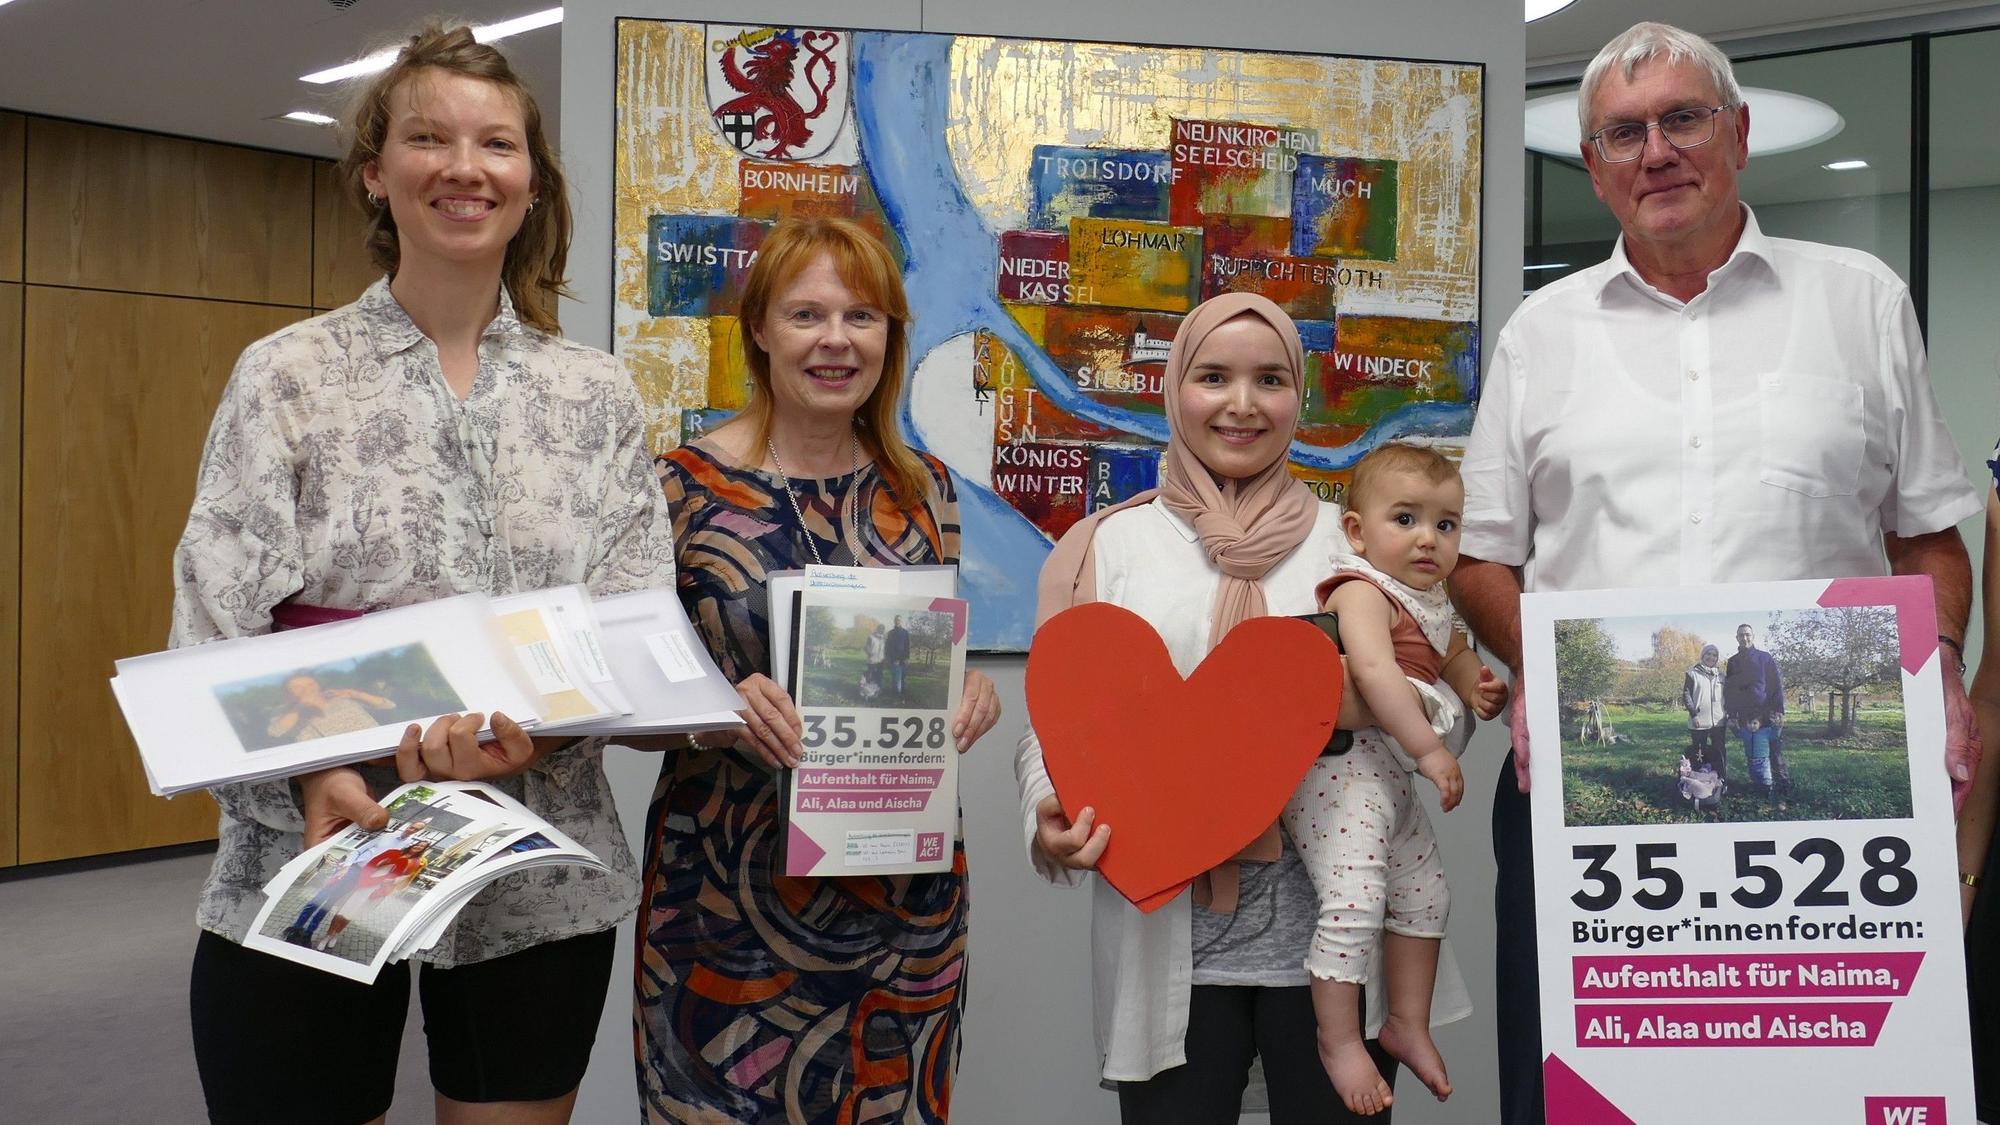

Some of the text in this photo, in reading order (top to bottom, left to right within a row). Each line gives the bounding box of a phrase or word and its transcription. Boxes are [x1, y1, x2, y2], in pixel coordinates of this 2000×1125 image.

[1177, 122, 1315, 150] NEUNKIRCHEN
[1039, 156, 1184, 185] TROISDORF
[1175, 145, 1298, 172] SEELSCHEID
[744, 170, 857, 195] BORNHEIM
[1311, 177, 1371, 199] MUCH
[1102, 227, 1185, 252] LOHMAR
[659, 242, 759, 269] SWISTTA
[1019, 281, 1100, 304] KASSEL
[1334, 352, 1432, 378] WINDECK
[1077, 366, 1164, 393] SIEGBU
[996, 475, 1083, 494] WINTER
[801, 715, 945, 749] 35.528
[802, 772, 936, 786] Aufenthalt für Naima,
[801, 797, 922, 810] Ali, Alaa und Aischa
[920, 847, 939, 858] ACT
[923, 837, 939, 847] WE
[1570, 836, 1918, 911] 35.528
[1582, 962, 1899, 990] Aufenthalt für Naima,
[1585, 1014, 1866, 1043] Ali, Alaa und Aischa
[1883, 1107, 1928, 1125] WE
